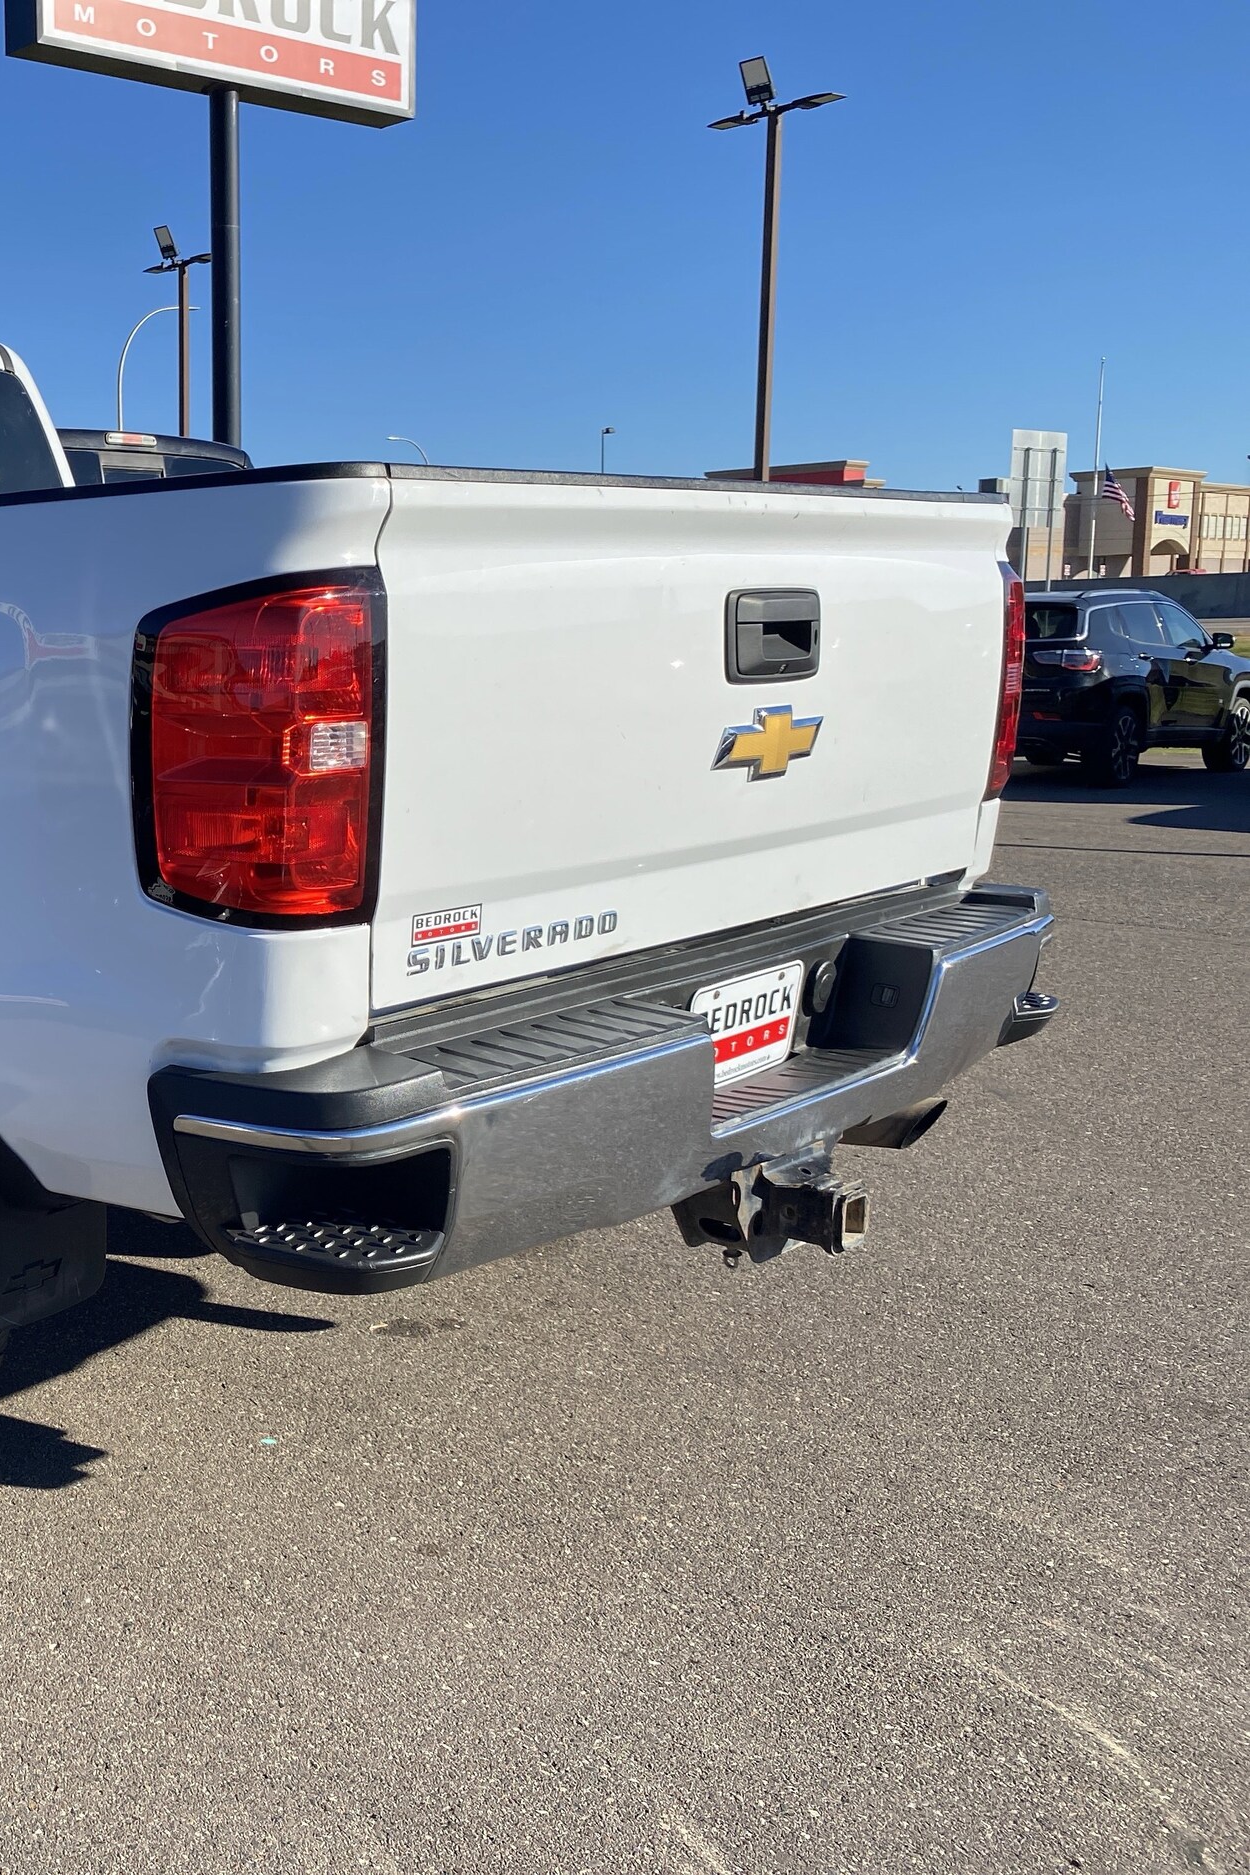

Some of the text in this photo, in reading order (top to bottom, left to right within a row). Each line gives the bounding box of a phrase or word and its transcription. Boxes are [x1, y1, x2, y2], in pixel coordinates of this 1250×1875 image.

[73, 3, 387, 87] MOTORS
[406, 908, 619, 976] SILVERADO
[415, 908, 479, 930] BEDROCK
[417, 923, 477, 940] MOTORS
[702, 984, 795, 1034] EDROCK
